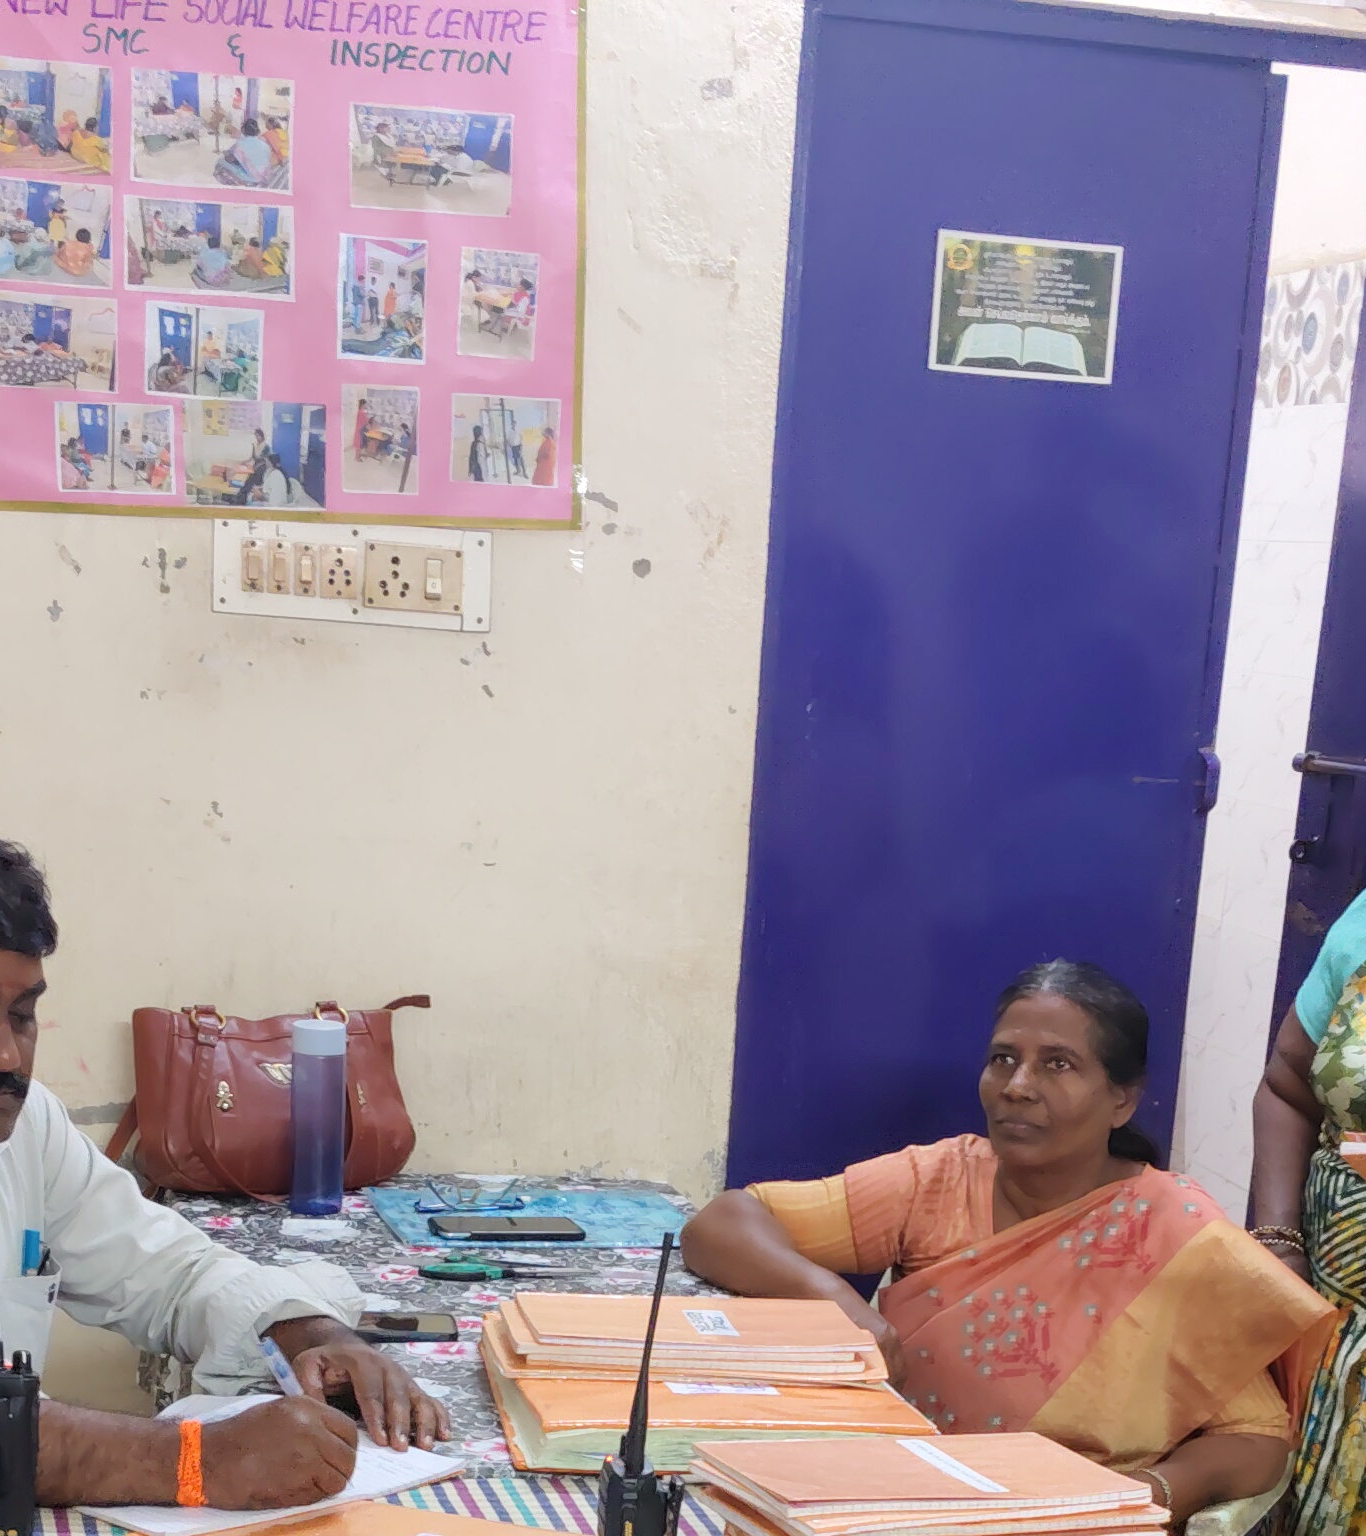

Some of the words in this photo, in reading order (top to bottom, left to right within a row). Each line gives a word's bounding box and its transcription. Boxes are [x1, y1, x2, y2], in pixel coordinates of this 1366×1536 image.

[90, 0, 166, 22] LIFE
[182, 0, 273, 28] SOCIAL
[284, 0, 421, 36] WELFARE
[424, 7, 547, 44] CENTRE
[82, 22, 150, 56] SMC
[329, 38, 512, 76] INSPECTION
